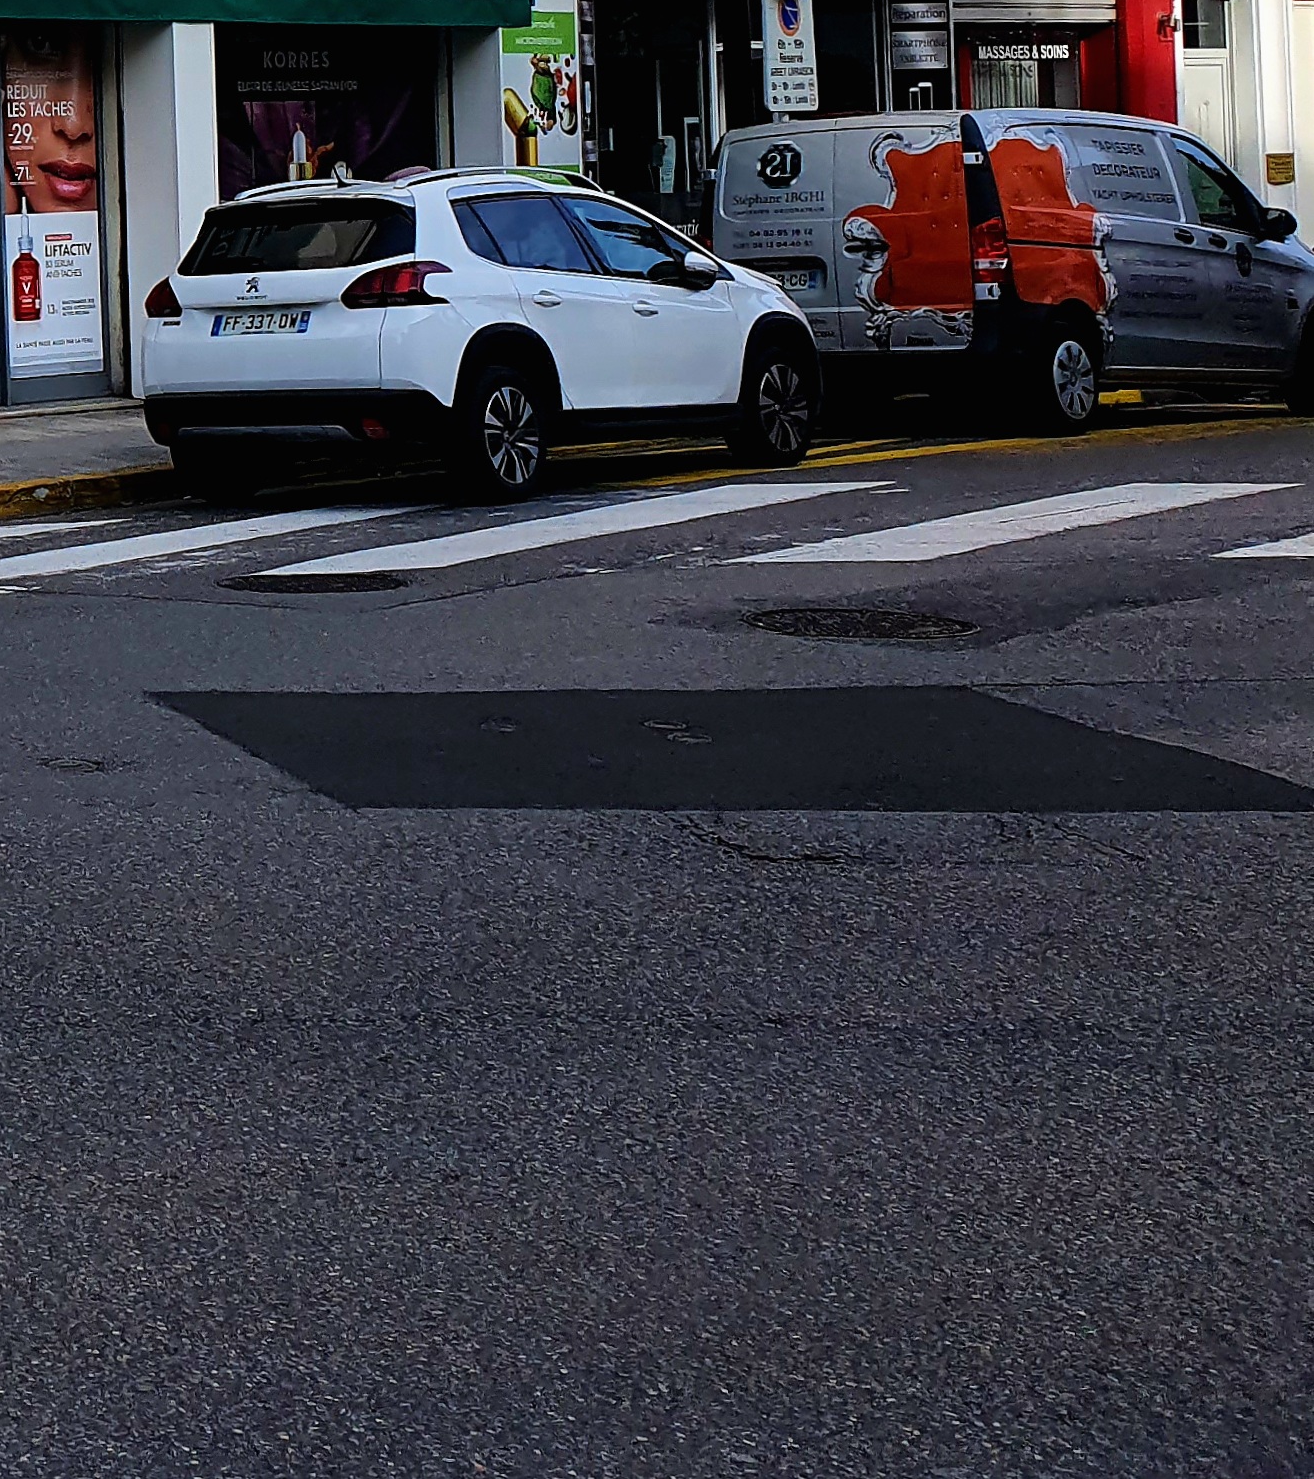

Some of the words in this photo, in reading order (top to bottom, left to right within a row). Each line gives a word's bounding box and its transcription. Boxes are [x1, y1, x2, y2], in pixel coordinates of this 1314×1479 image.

[263, 51, 330, 68] KORRES
[978, 45, 1030, 59] MASSAGES
[1032, 44, 1039, 59] &
[1040, 44, 1069, 59] SOINS
[6, 80, 48, 100] RÉDUIT
[7, 102, 26, 118] LES
[29, 101, 74, 117] TACHES
[44, 243, 92, 257] LIFTACTIV
[223, 313, 299, 331] FF-337-DW
